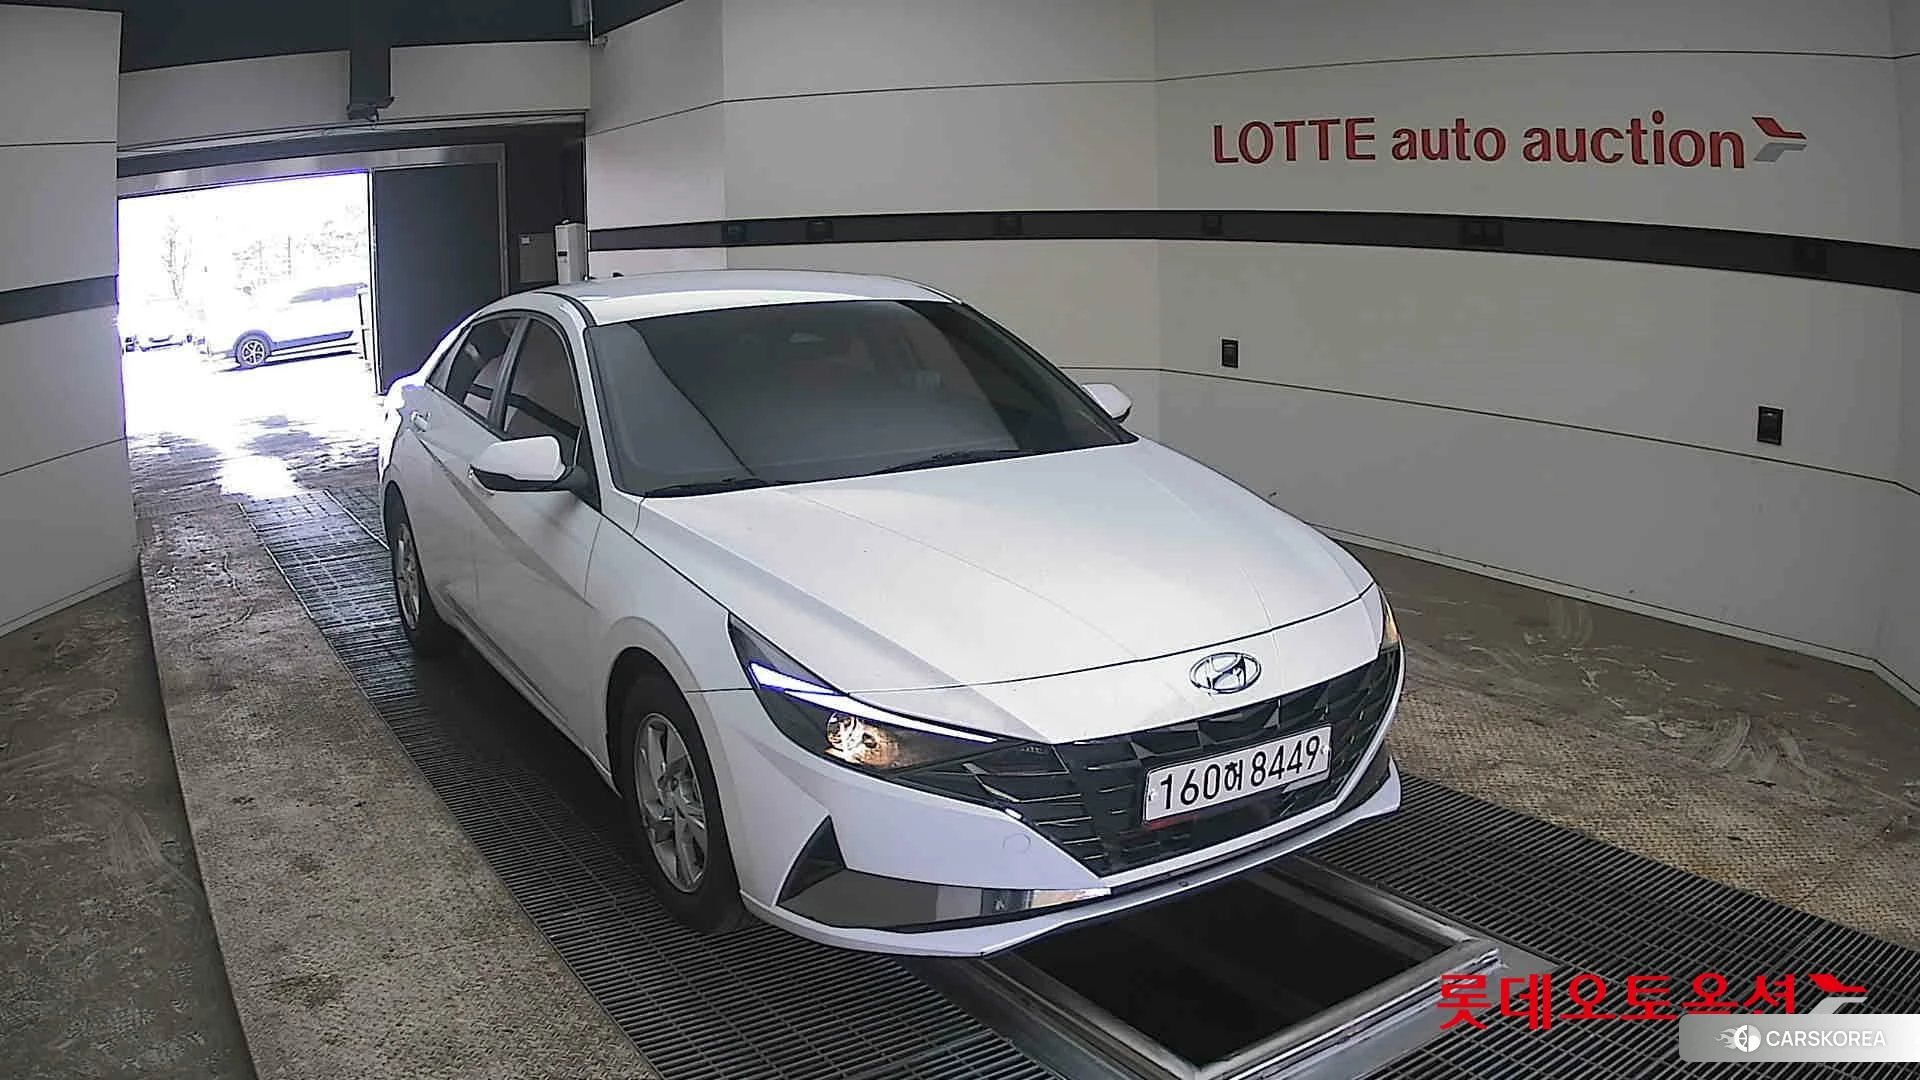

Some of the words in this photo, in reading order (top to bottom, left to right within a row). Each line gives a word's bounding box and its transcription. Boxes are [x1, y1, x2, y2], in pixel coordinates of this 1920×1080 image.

[1213, 117, 1376, 164] LOTTE
[1392, 119, 1506, 161] auto
[1523, 111, 1744, 168] auction
[1251, 735, 1320, 787] 8449
